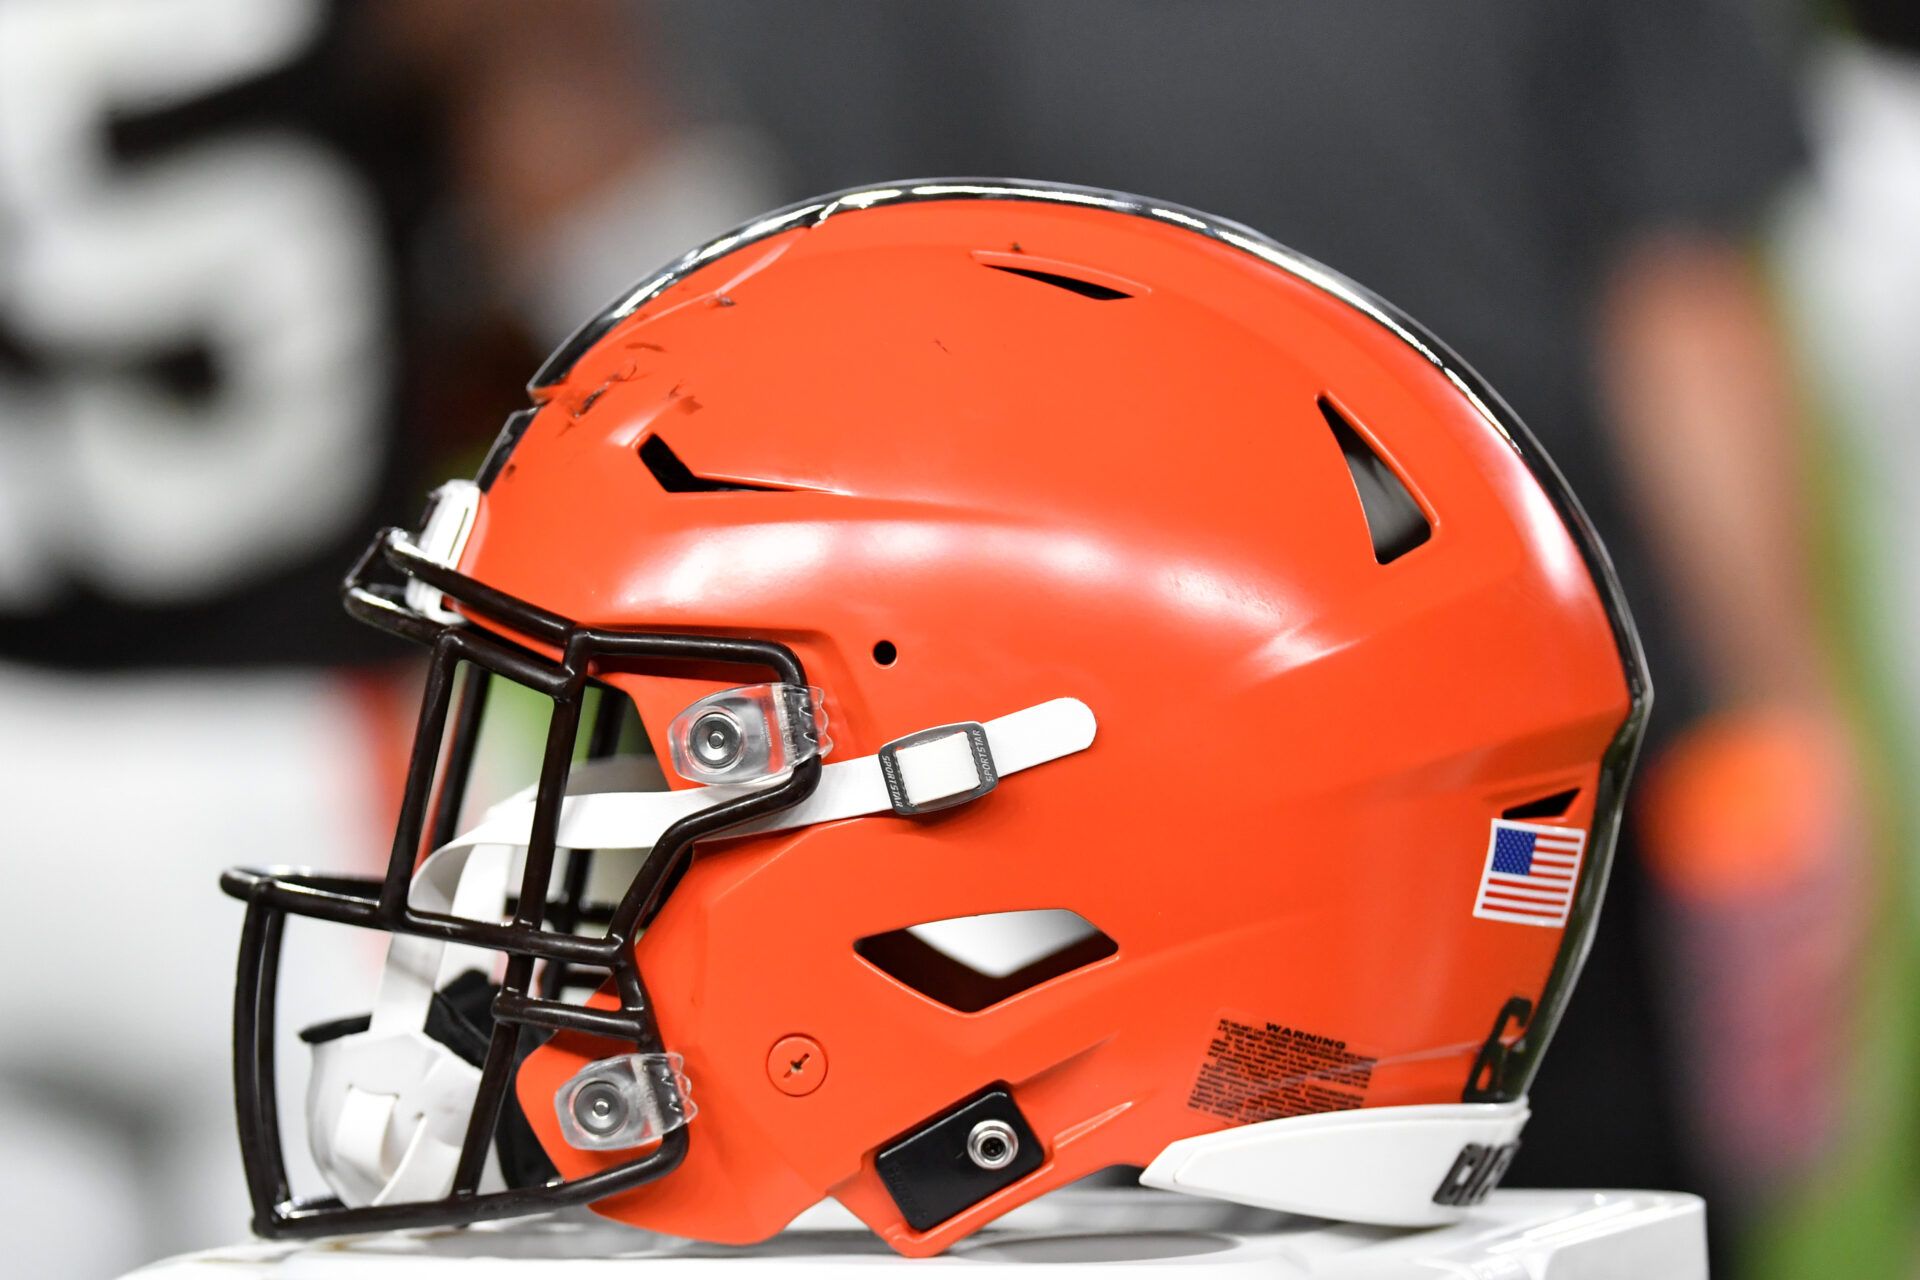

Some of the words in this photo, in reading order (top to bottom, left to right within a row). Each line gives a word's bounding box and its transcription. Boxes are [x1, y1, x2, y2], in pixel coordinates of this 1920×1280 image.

[880, 754, 904, 808] SPORTSTAR
[971, 729, 995, 783] SPORTSTAR
[1265, 1021, 1347, 1051] WARNING
